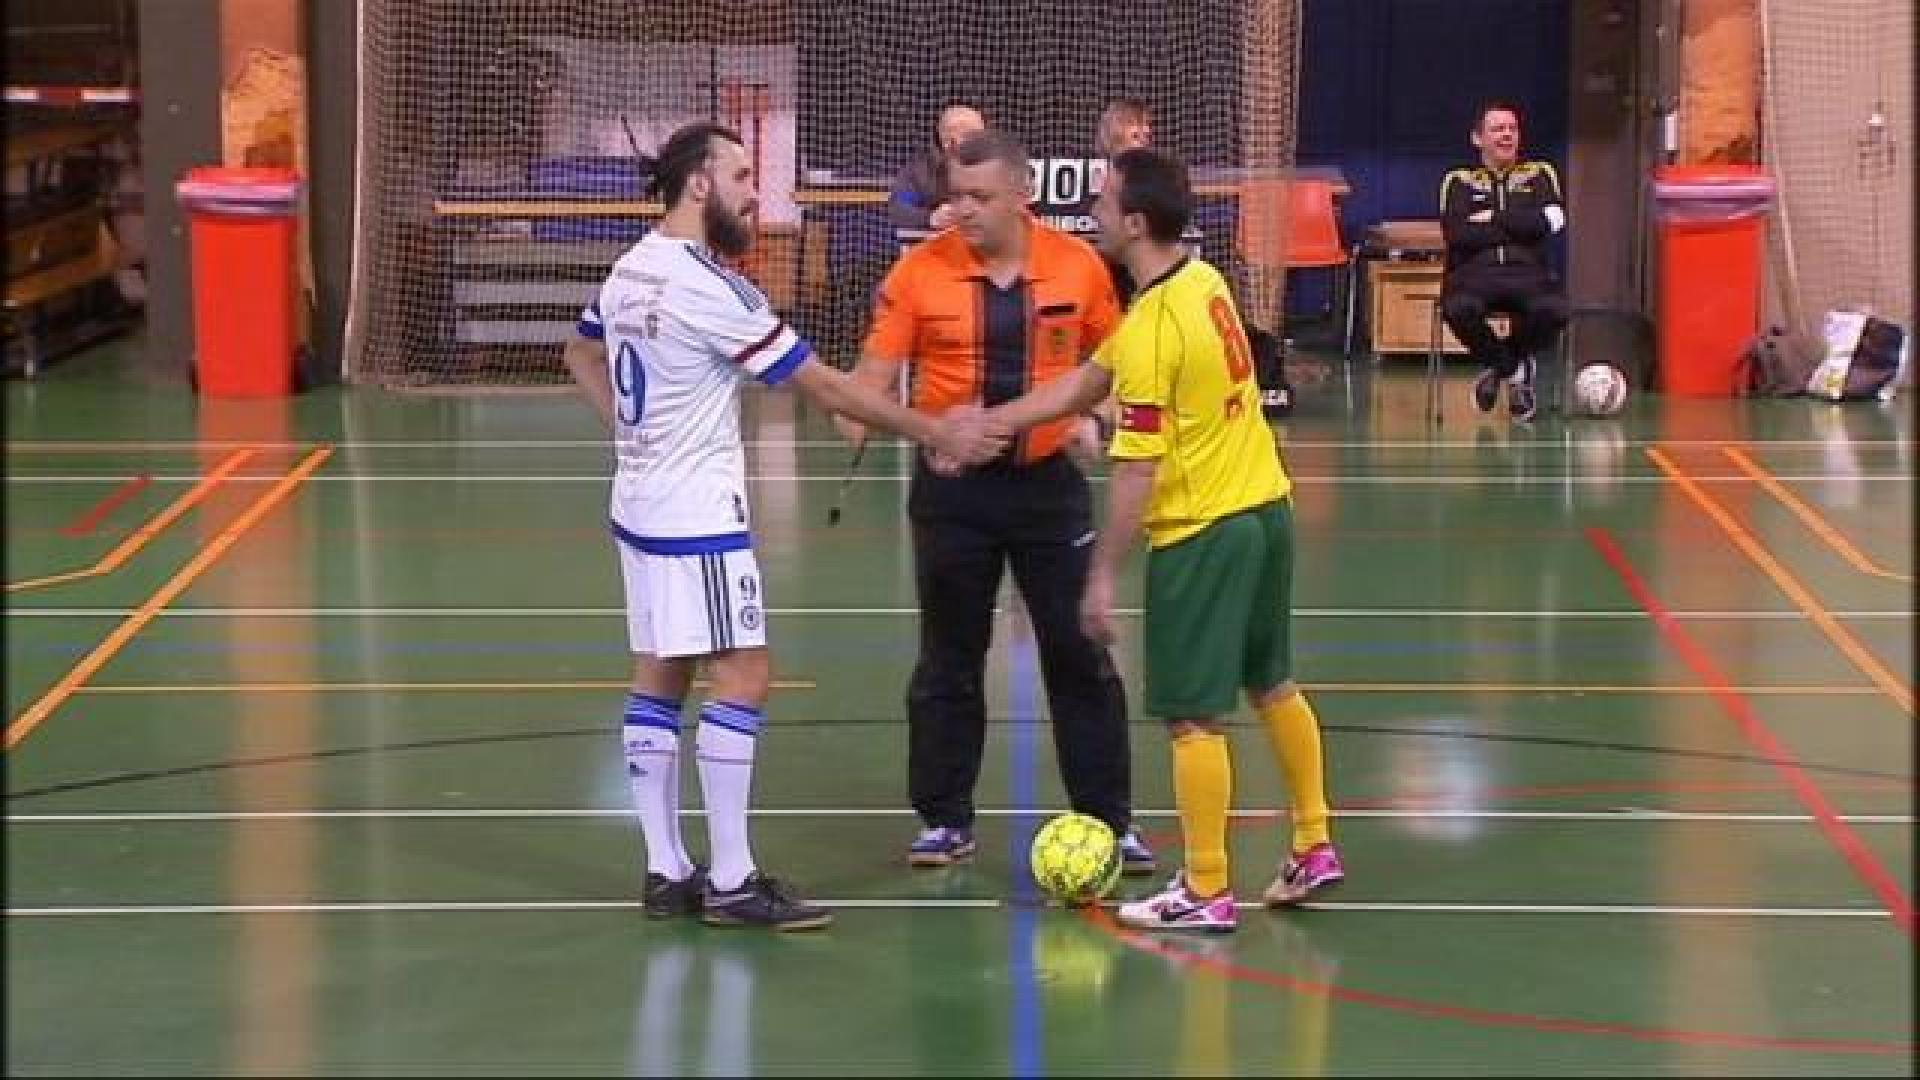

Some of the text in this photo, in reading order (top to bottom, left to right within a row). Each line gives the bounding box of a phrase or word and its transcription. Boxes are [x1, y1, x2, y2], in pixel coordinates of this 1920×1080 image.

[1055, 165, 1077, 199] 0
[614, 340, 646, 426] 9
[738, 575, 757, 601] 9
